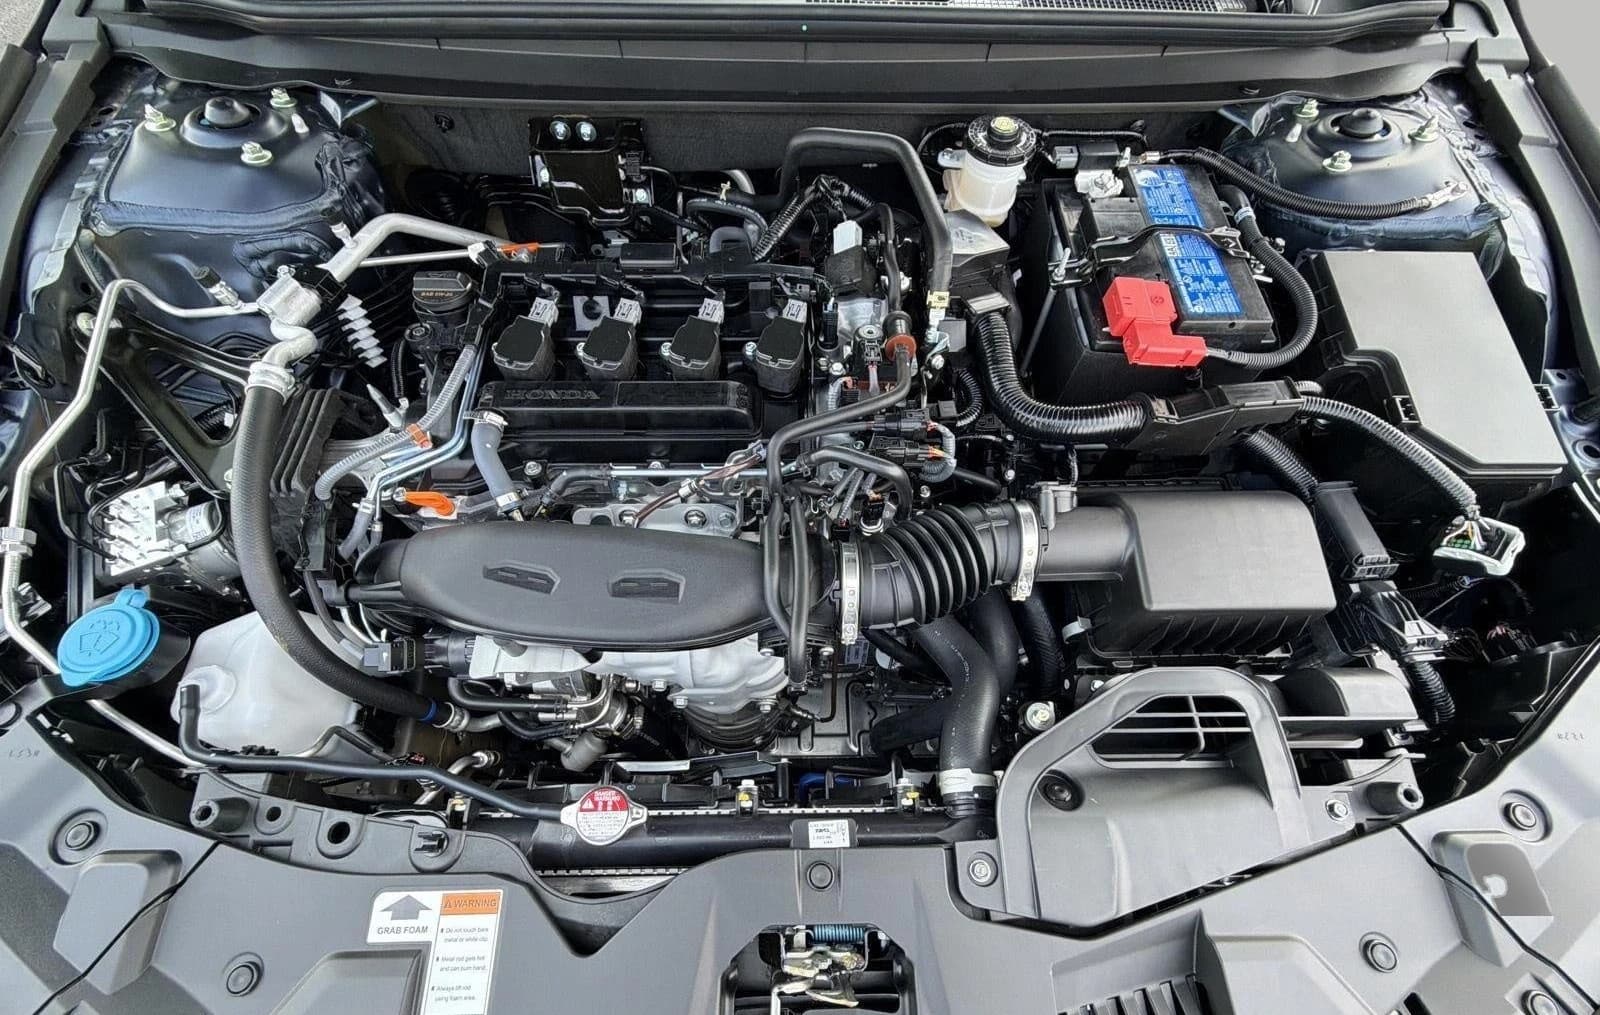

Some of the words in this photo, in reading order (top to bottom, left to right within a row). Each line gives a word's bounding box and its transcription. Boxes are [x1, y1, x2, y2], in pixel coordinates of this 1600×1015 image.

[505, 389, 600, 400] HONDA
[453, 898, 497, 908] WARNING
[377, 926, 402, 935] GRAB
[403, 925, 428, 934] FOAM
